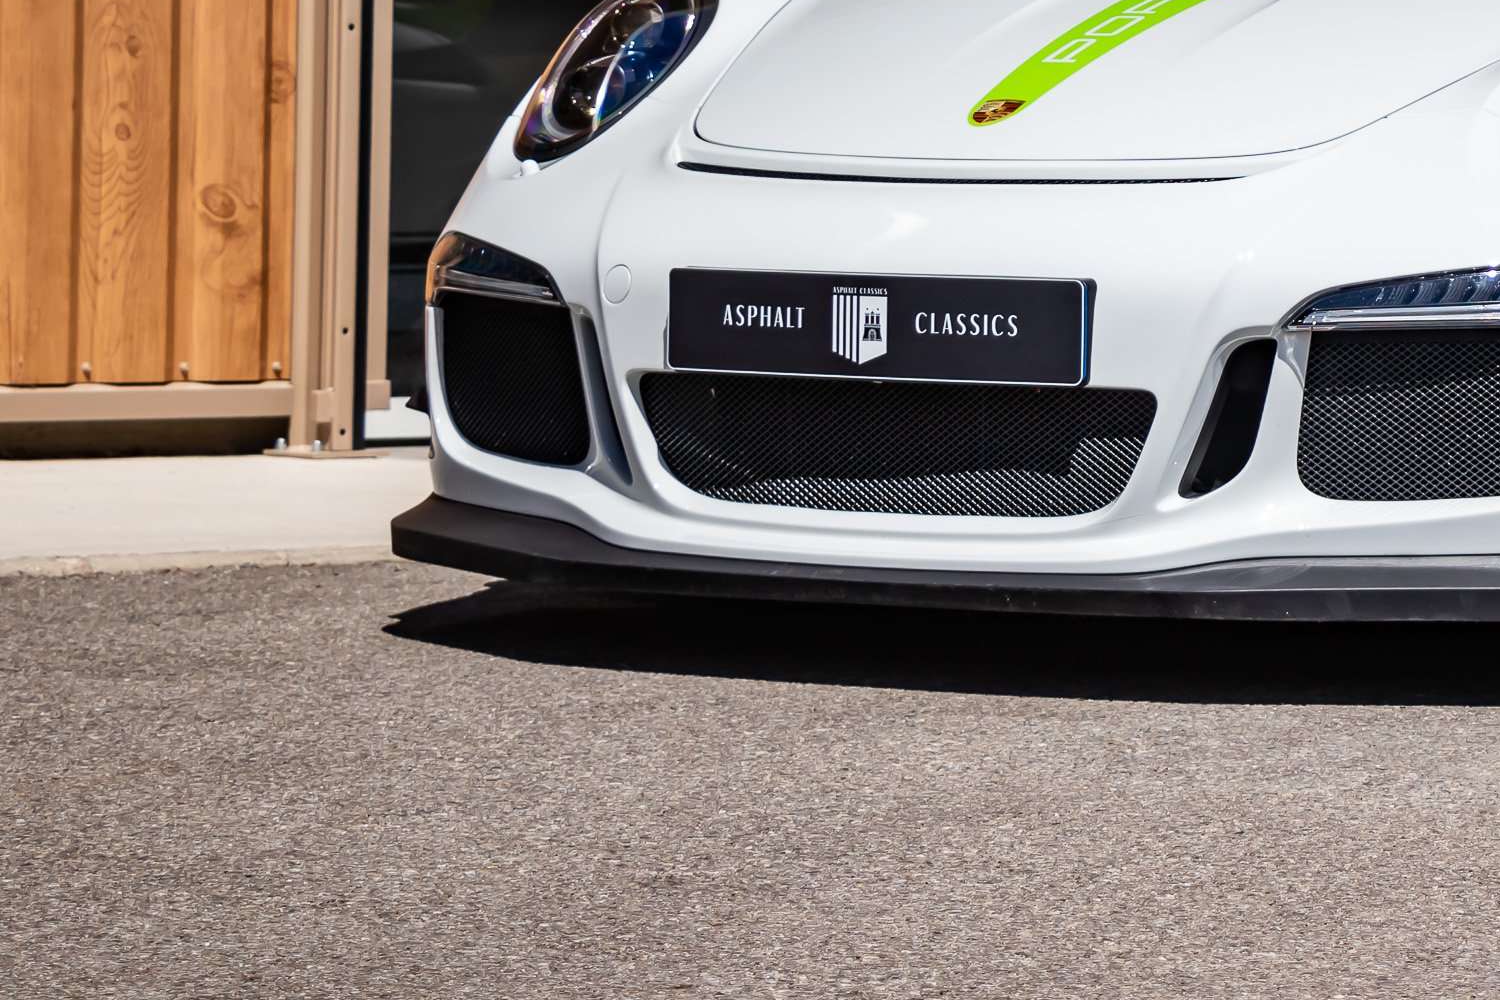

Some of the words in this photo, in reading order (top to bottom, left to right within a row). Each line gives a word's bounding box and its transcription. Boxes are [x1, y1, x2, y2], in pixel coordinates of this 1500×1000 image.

[833, 286, 857, 294] ASPHALT
[859, 287, 888, 295] CLASSICS
[723, 304, 806, 329] ASPHALT
[915, 311, 1019, 338] CLASSICS
